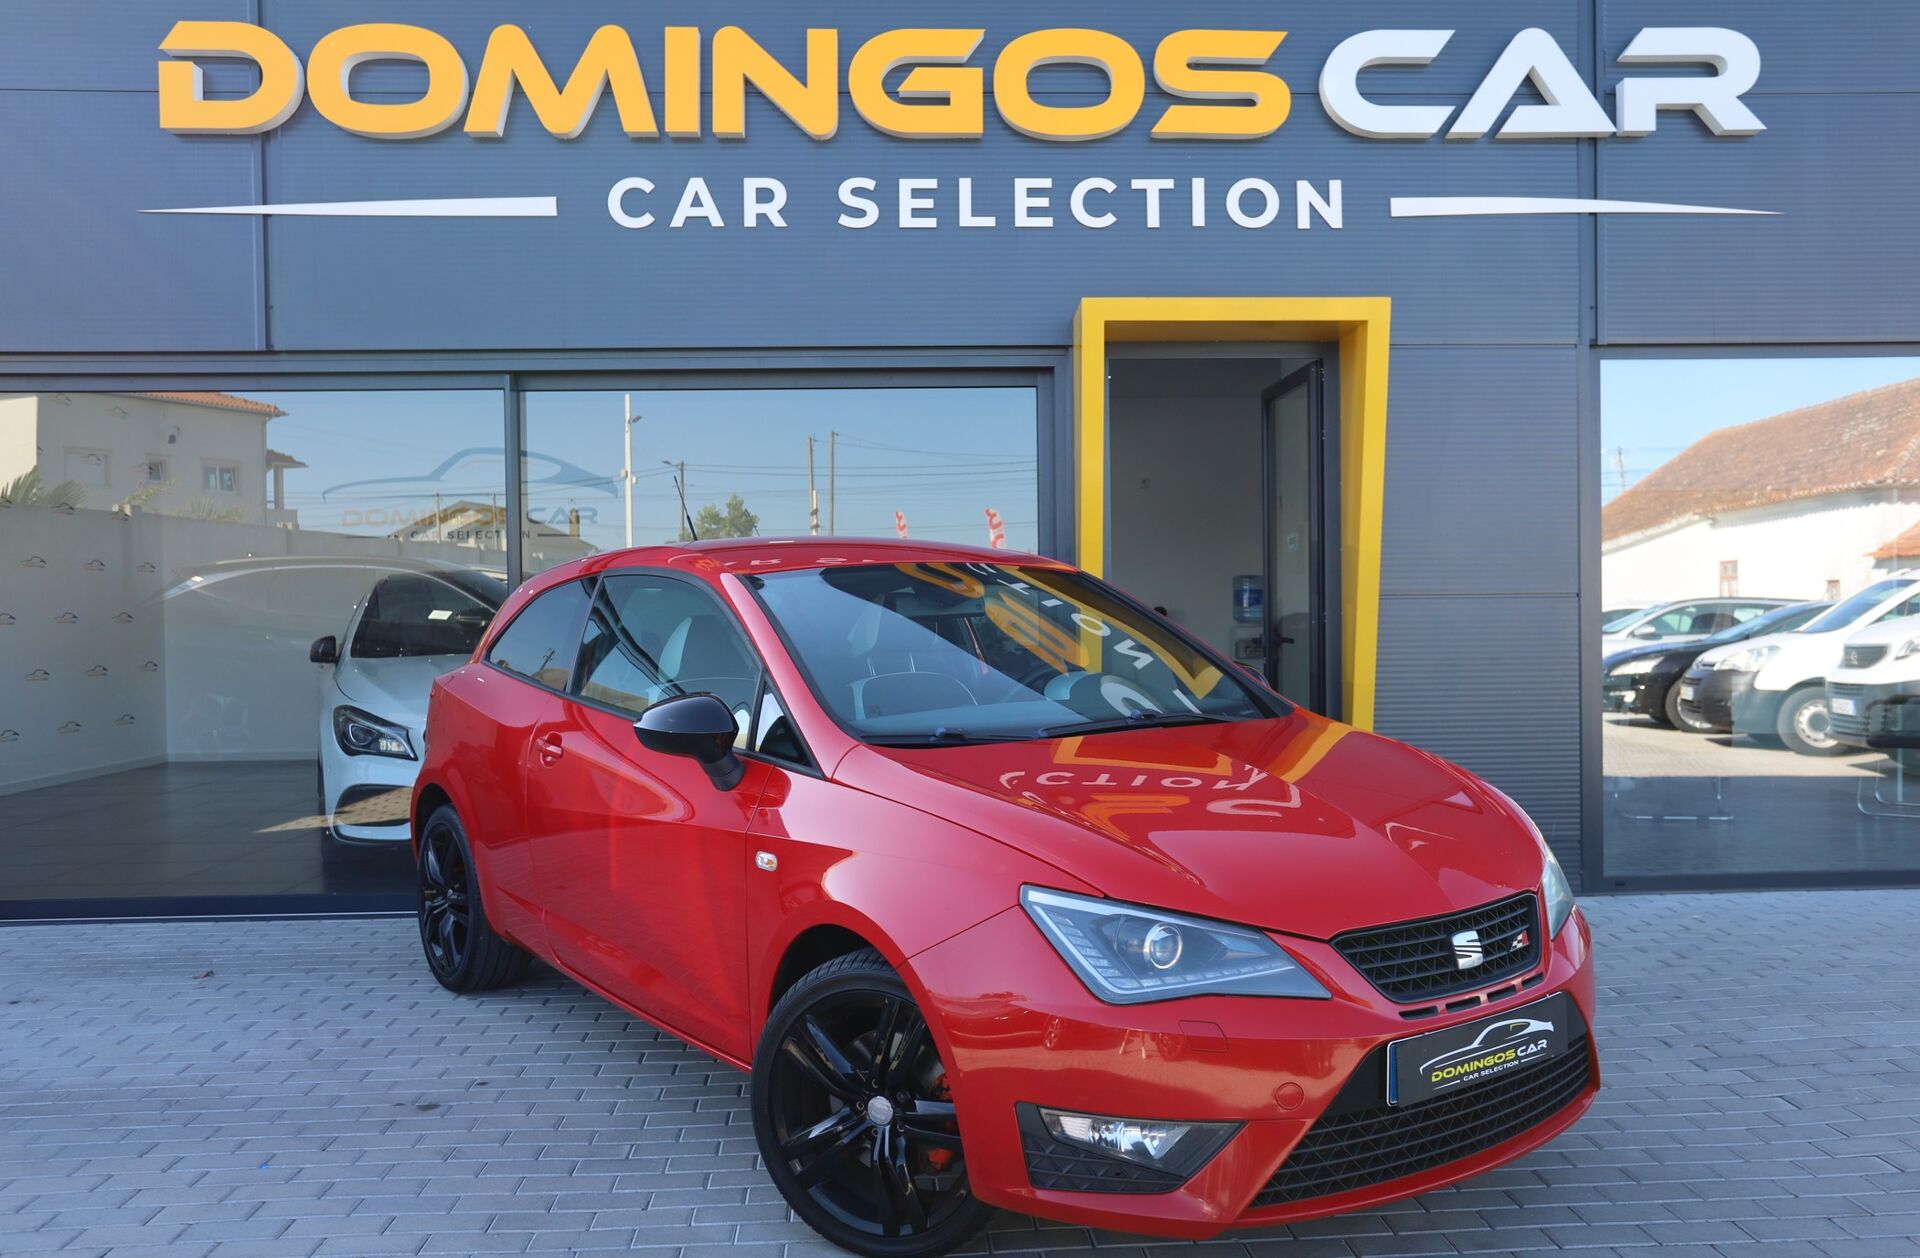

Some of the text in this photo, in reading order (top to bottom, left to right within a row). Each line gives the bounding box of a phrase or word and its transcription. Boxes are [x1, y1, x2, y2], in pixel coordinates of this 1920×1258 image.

[158, 20, 1767, 140] DOMINGOS CAR
[607, 177, 1343, 230] CAR SELECTION
[1431, 1039, 1548, 1083] DOMINGOS CAR
[1463, 1060, 1519, 1082] CAR SELECTION
